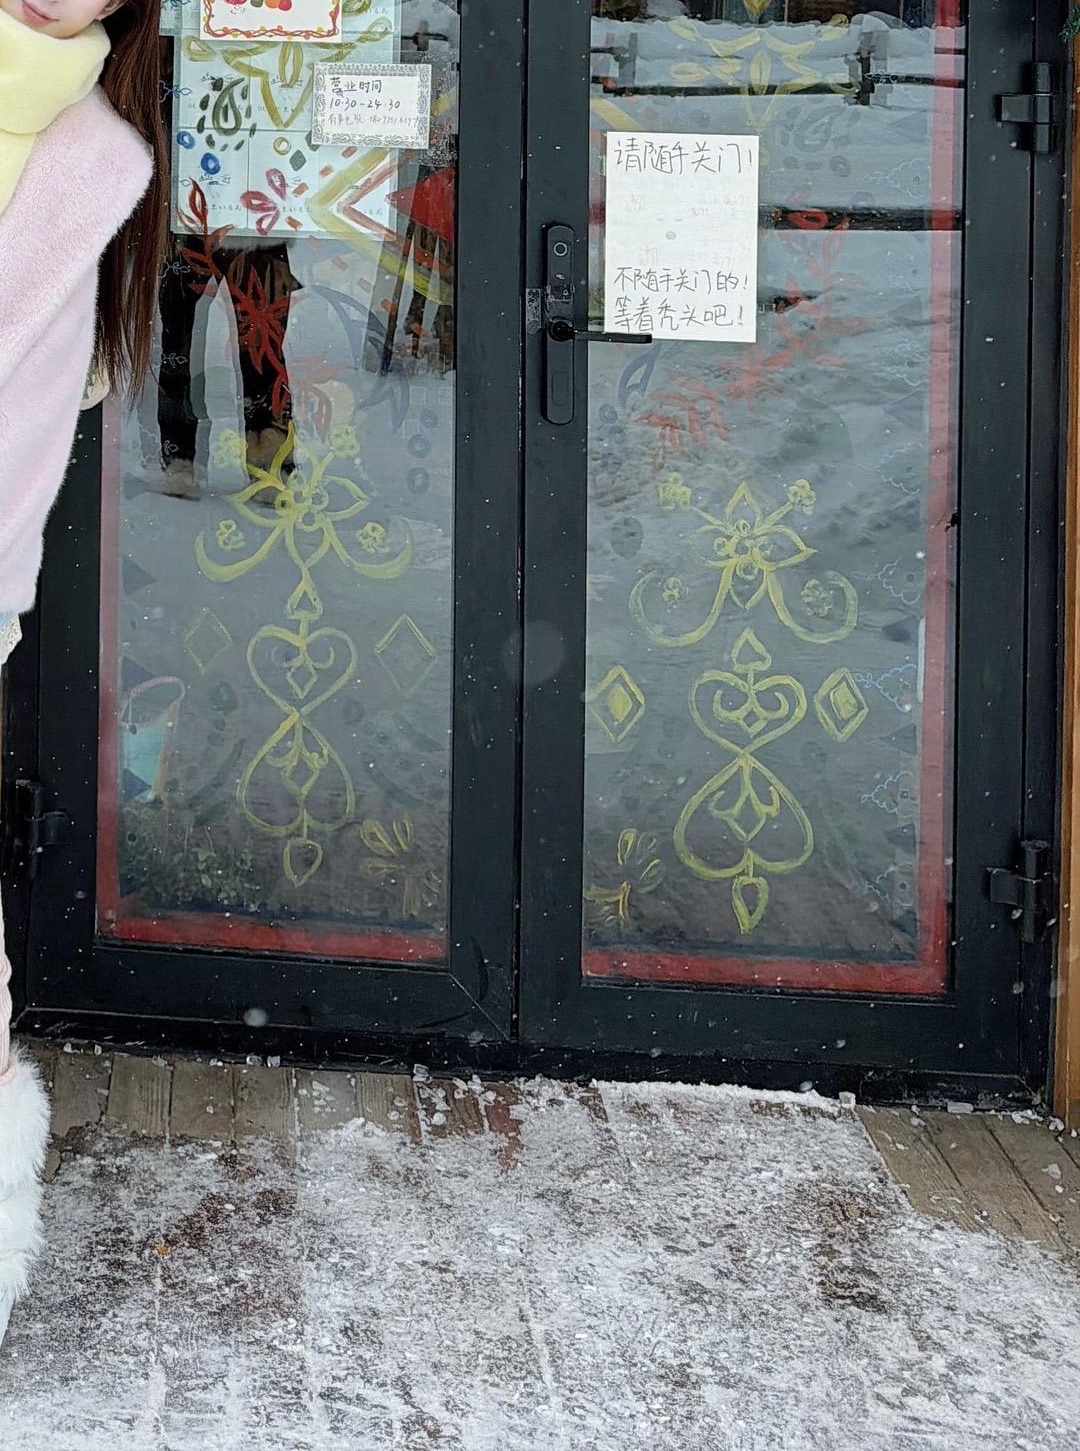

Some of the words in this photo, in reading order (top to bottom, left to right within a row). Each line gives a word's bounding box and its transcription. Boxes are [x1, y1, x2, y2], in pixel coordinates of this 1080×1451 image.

[329, 76, 382, 96] 营业时间
[614, 266, 749, 294] 不随手关门的!
[614, 295, 744, 333] 等着秃头吧!
